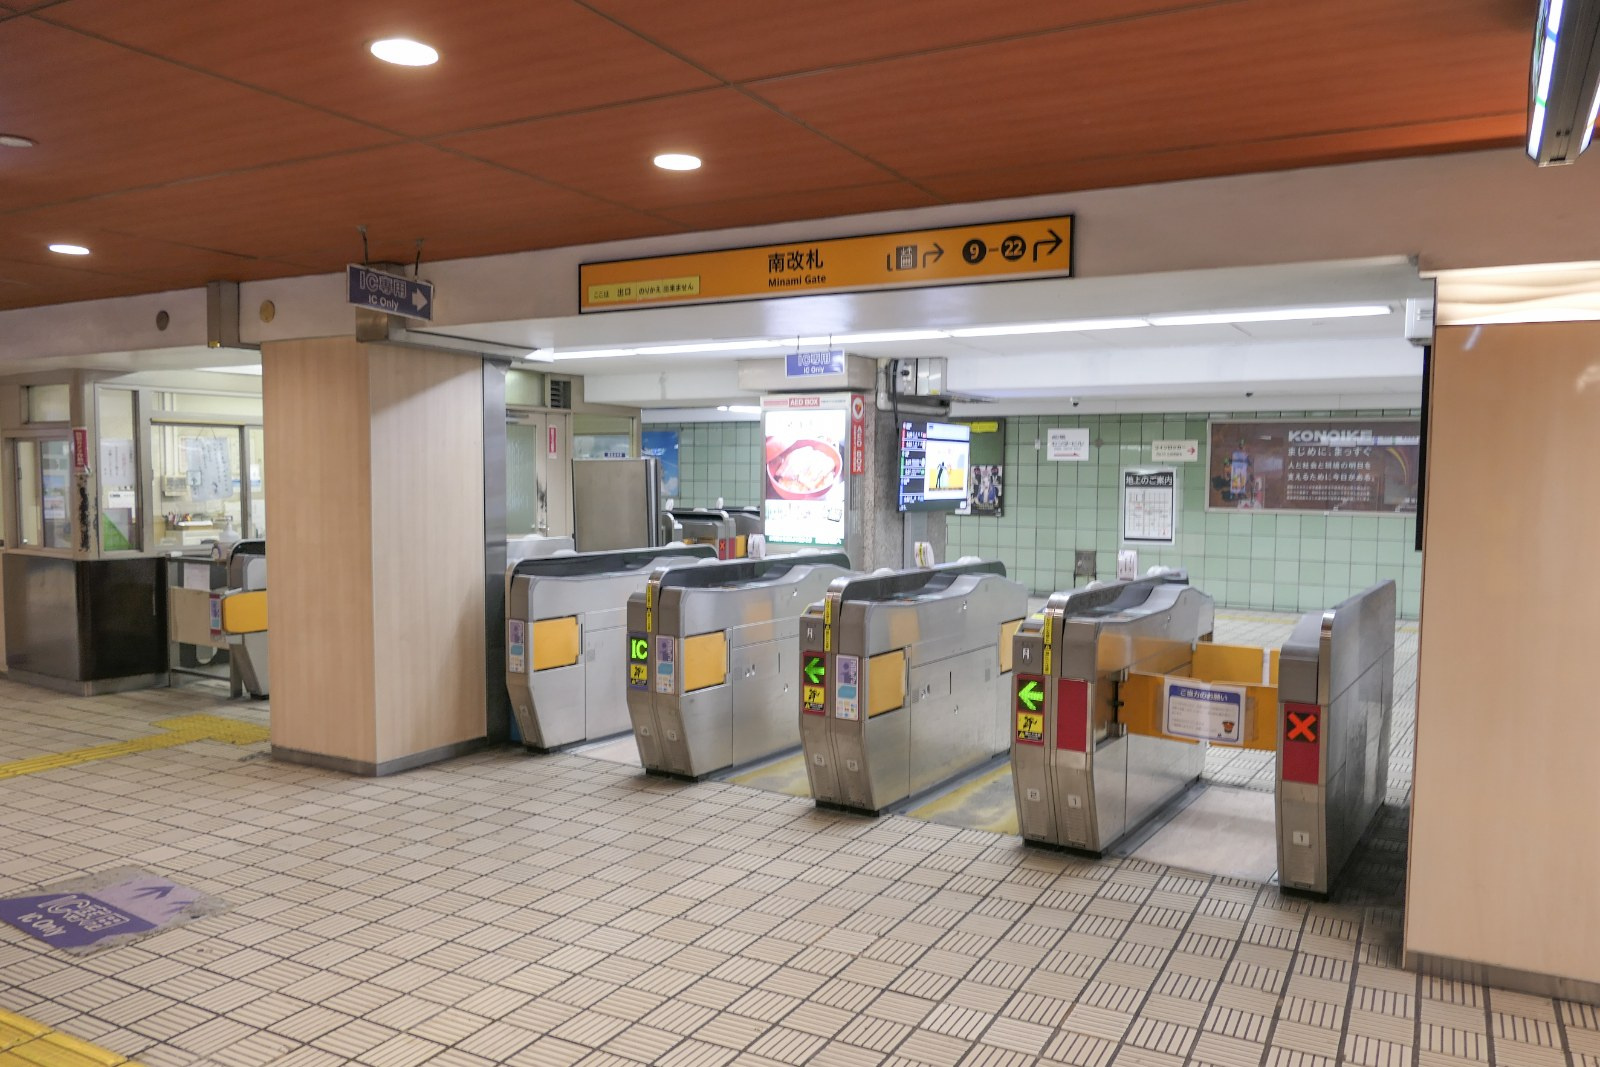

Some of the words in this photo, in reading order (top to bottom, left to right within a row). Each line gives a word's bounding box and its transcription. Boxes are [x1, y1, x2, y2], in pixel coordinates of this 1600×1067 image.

[768, 248, 824, 273] 南改札
[768, 275, 802, 287] Minami
[805, 274, 827, 285] Gate
[617, 287, 632, 297] 出口
[368, 294, 378, 305] IC
[380, 296, 399, 311] Only
[1288, 429, 1373, 443] KONOIKE
[1125, 474, 1173, 487] 地上のご案内
[631, 638, 648, 660] IC
